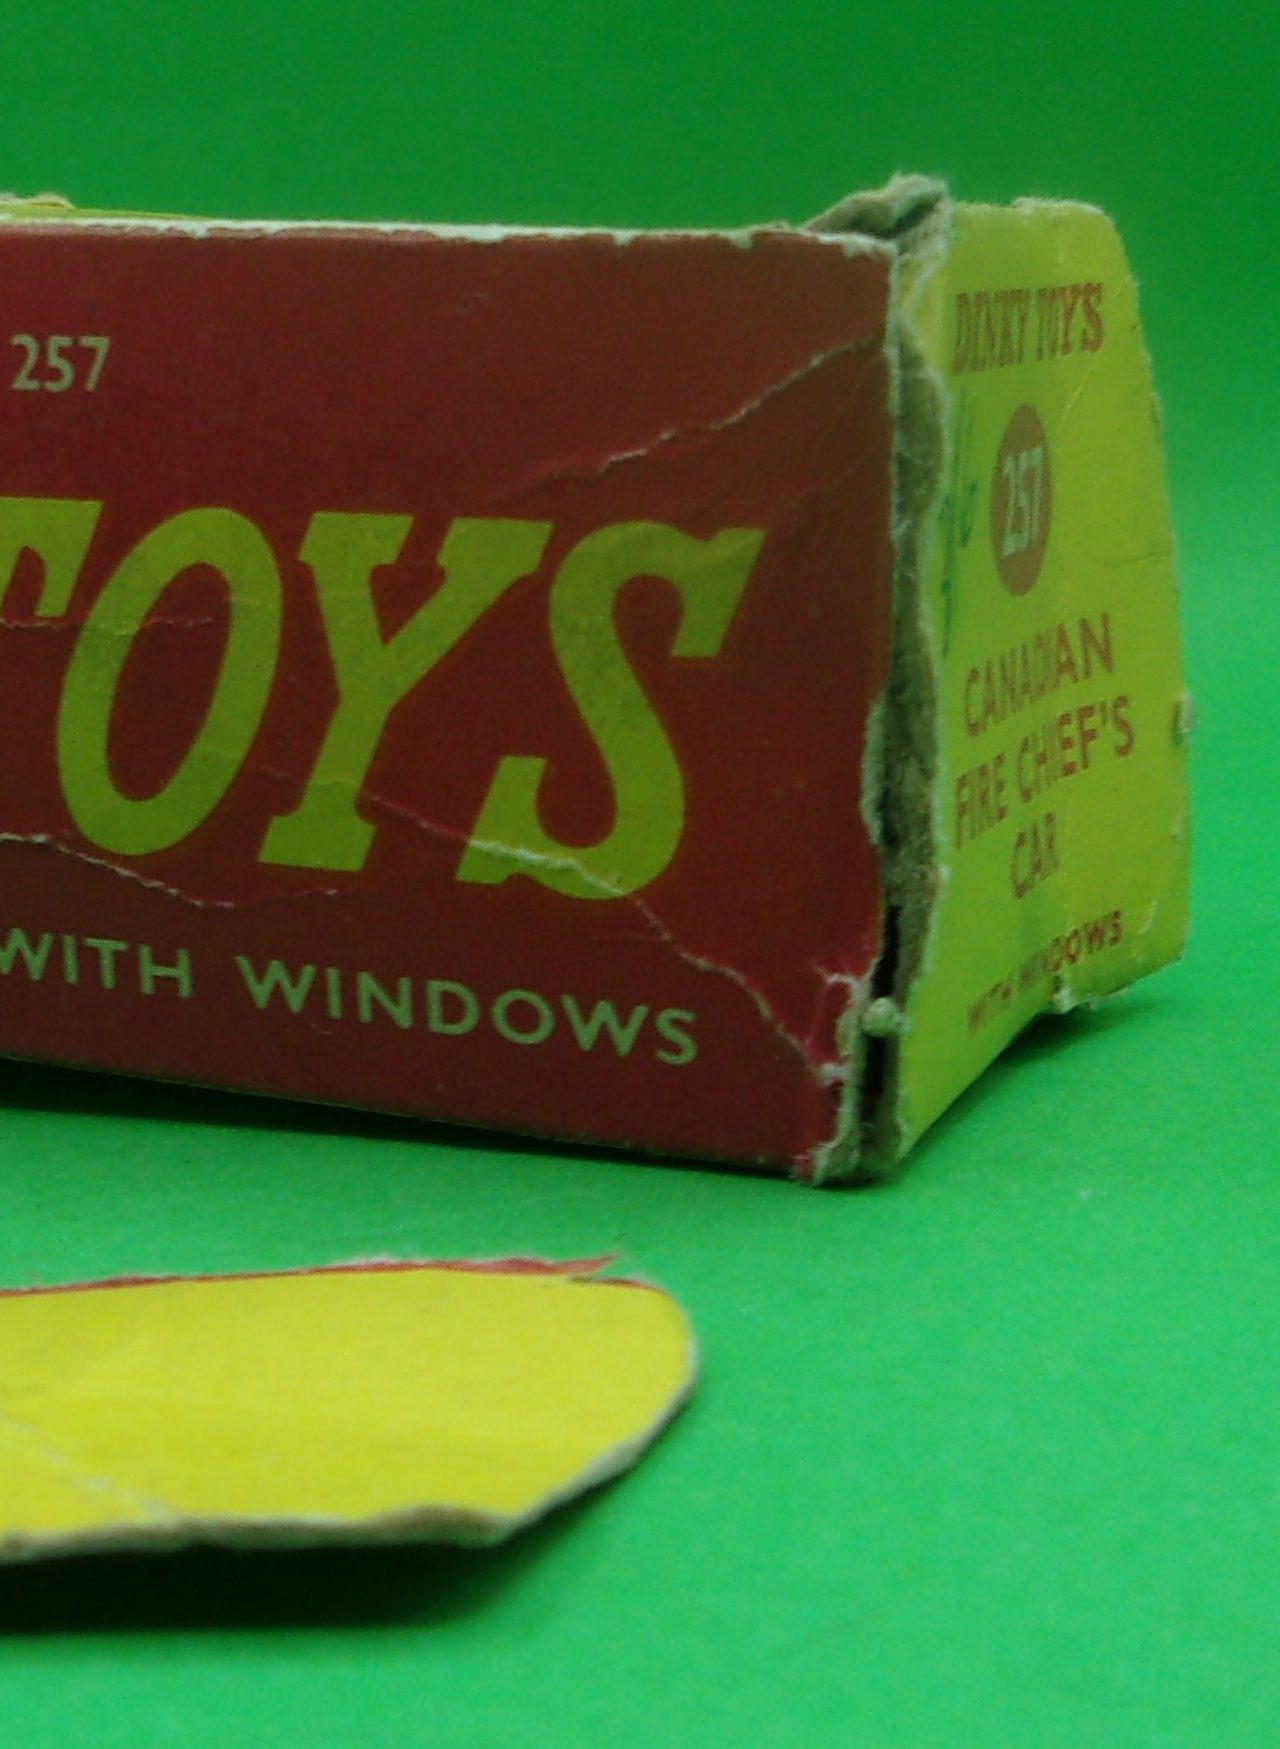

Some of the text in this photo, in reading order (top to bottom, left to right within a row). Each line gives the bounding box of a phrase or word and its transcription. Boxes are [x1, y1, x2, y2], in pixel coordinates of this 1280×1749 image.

[10, 334, 112, 392] 257
[951, 281, 1105, 376] DINKY TOYS
[1000, 446, 1044, 557] 257
[964, 611, 1115, 738] CANADIAN
[955, 694, 1135, 850] FIRE CHIEF'S
[1011, 811, 1062, 900] CAR
[235, 954, 699, 1067] WINDOWS
